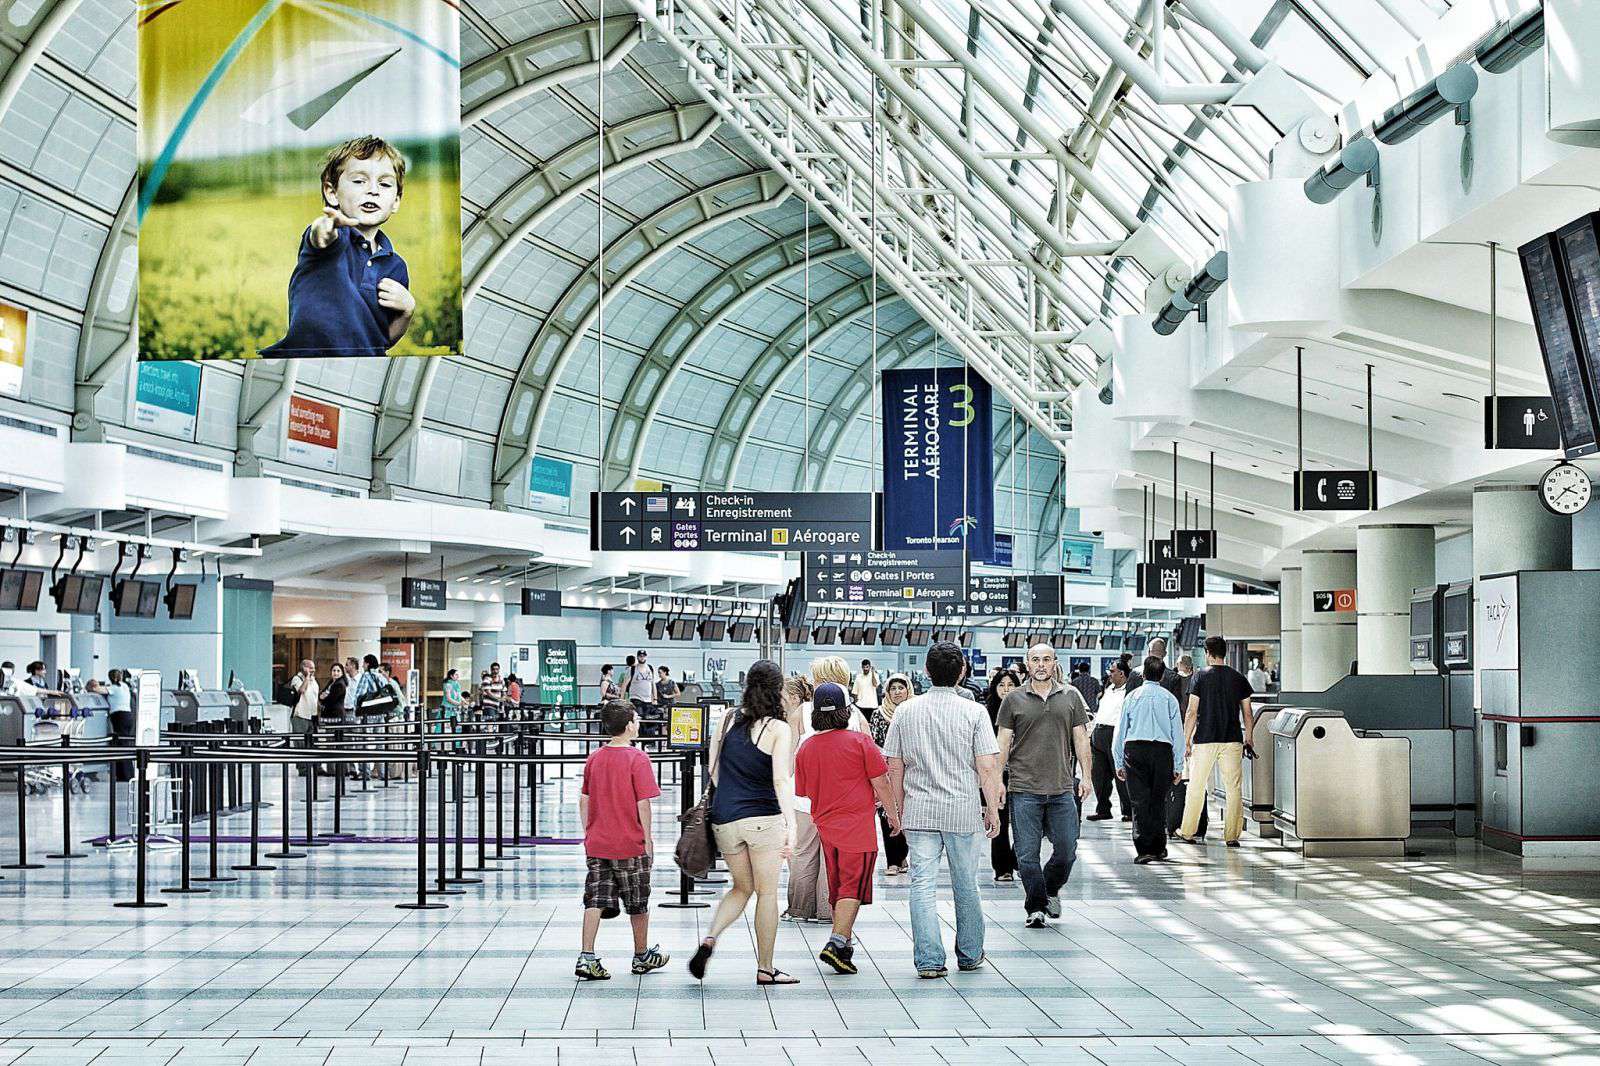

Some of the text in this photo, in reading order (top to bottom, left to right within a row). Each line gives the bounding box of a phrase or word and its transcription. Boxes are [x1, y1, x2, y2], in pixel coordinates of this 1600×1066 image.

[948, 384, 975, 427] 3
[903, 384, 919, 480] TERMINAL
[921, 384, 940, 480] AÉROGARE
[706, 495, 754, 505] Check-in
[706, 508, 792, 519] Enregistrement
[705, 529, 767, 542] Terminal
[793, 529, 861, 545] Aérogare
[906, 536, 960, 544] Toronto Pearson
[867, 559, 919, 567] Enregistrement
[874, 571, 899, 580] Gates
[906, 571, 935, 580] Portes
[867, 588, 902, 597] Terminal
[916, 588, 955, 598] Aérogare
[546, 657, 568, 665] Citizens
[543, 683, 573, 692] Passengers
